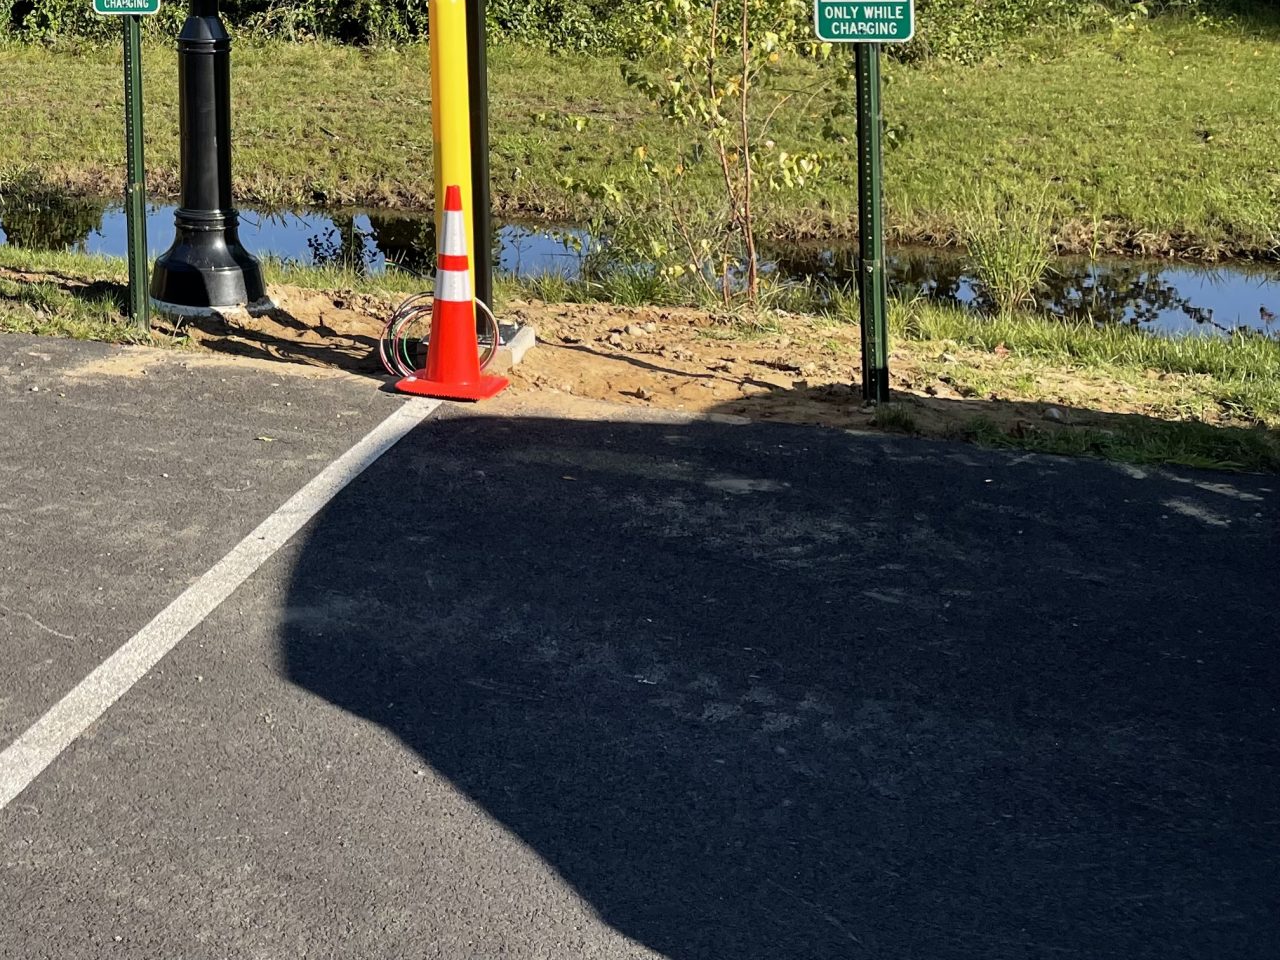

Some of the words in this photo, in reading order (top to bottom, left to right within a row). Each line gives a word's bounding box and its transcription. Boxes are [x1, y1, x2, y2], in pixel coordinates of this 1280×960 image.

[825, 6, 859, 19] ONLY
[864, 6, 903, 18] WHILE
[831, 22, 897, 35] CHARGING
